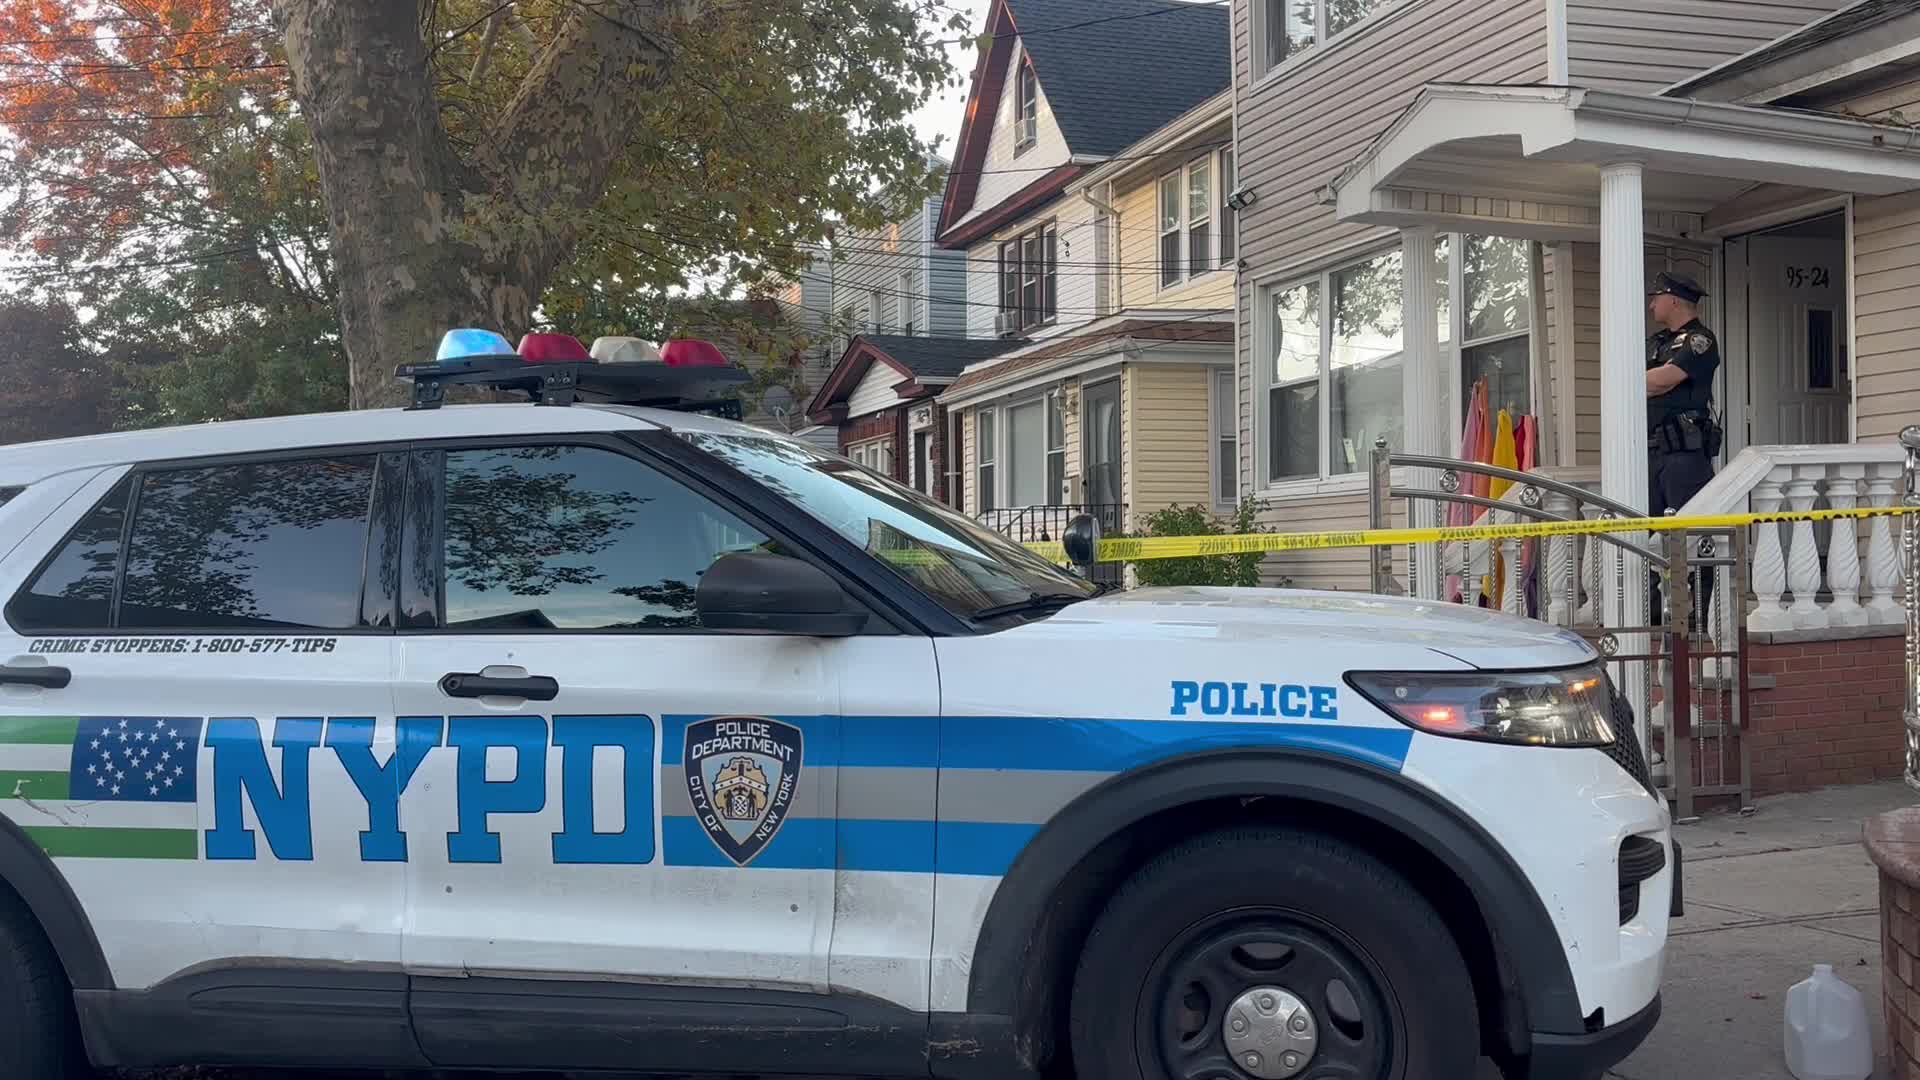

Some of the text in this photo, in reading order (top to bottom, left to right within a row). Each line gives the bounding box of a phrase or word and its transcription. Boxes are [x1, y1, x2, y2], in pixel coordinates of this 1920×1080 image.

[1786, 266, 1830, 289] 95-24
[29, 637, 337, 654] CRIME STOPPERS: 1-800-577-TIPS
[1170, 680, 1338, 721] POLICE
[715, 721, 771, 738] POLICE
[691, 736, 794, 762] DEPARTMENT
[203, 714, 656, 865] NYPD
[689, 775, 723, 833] CITY OF
[755, 772, 794, 841] NEW YORK
